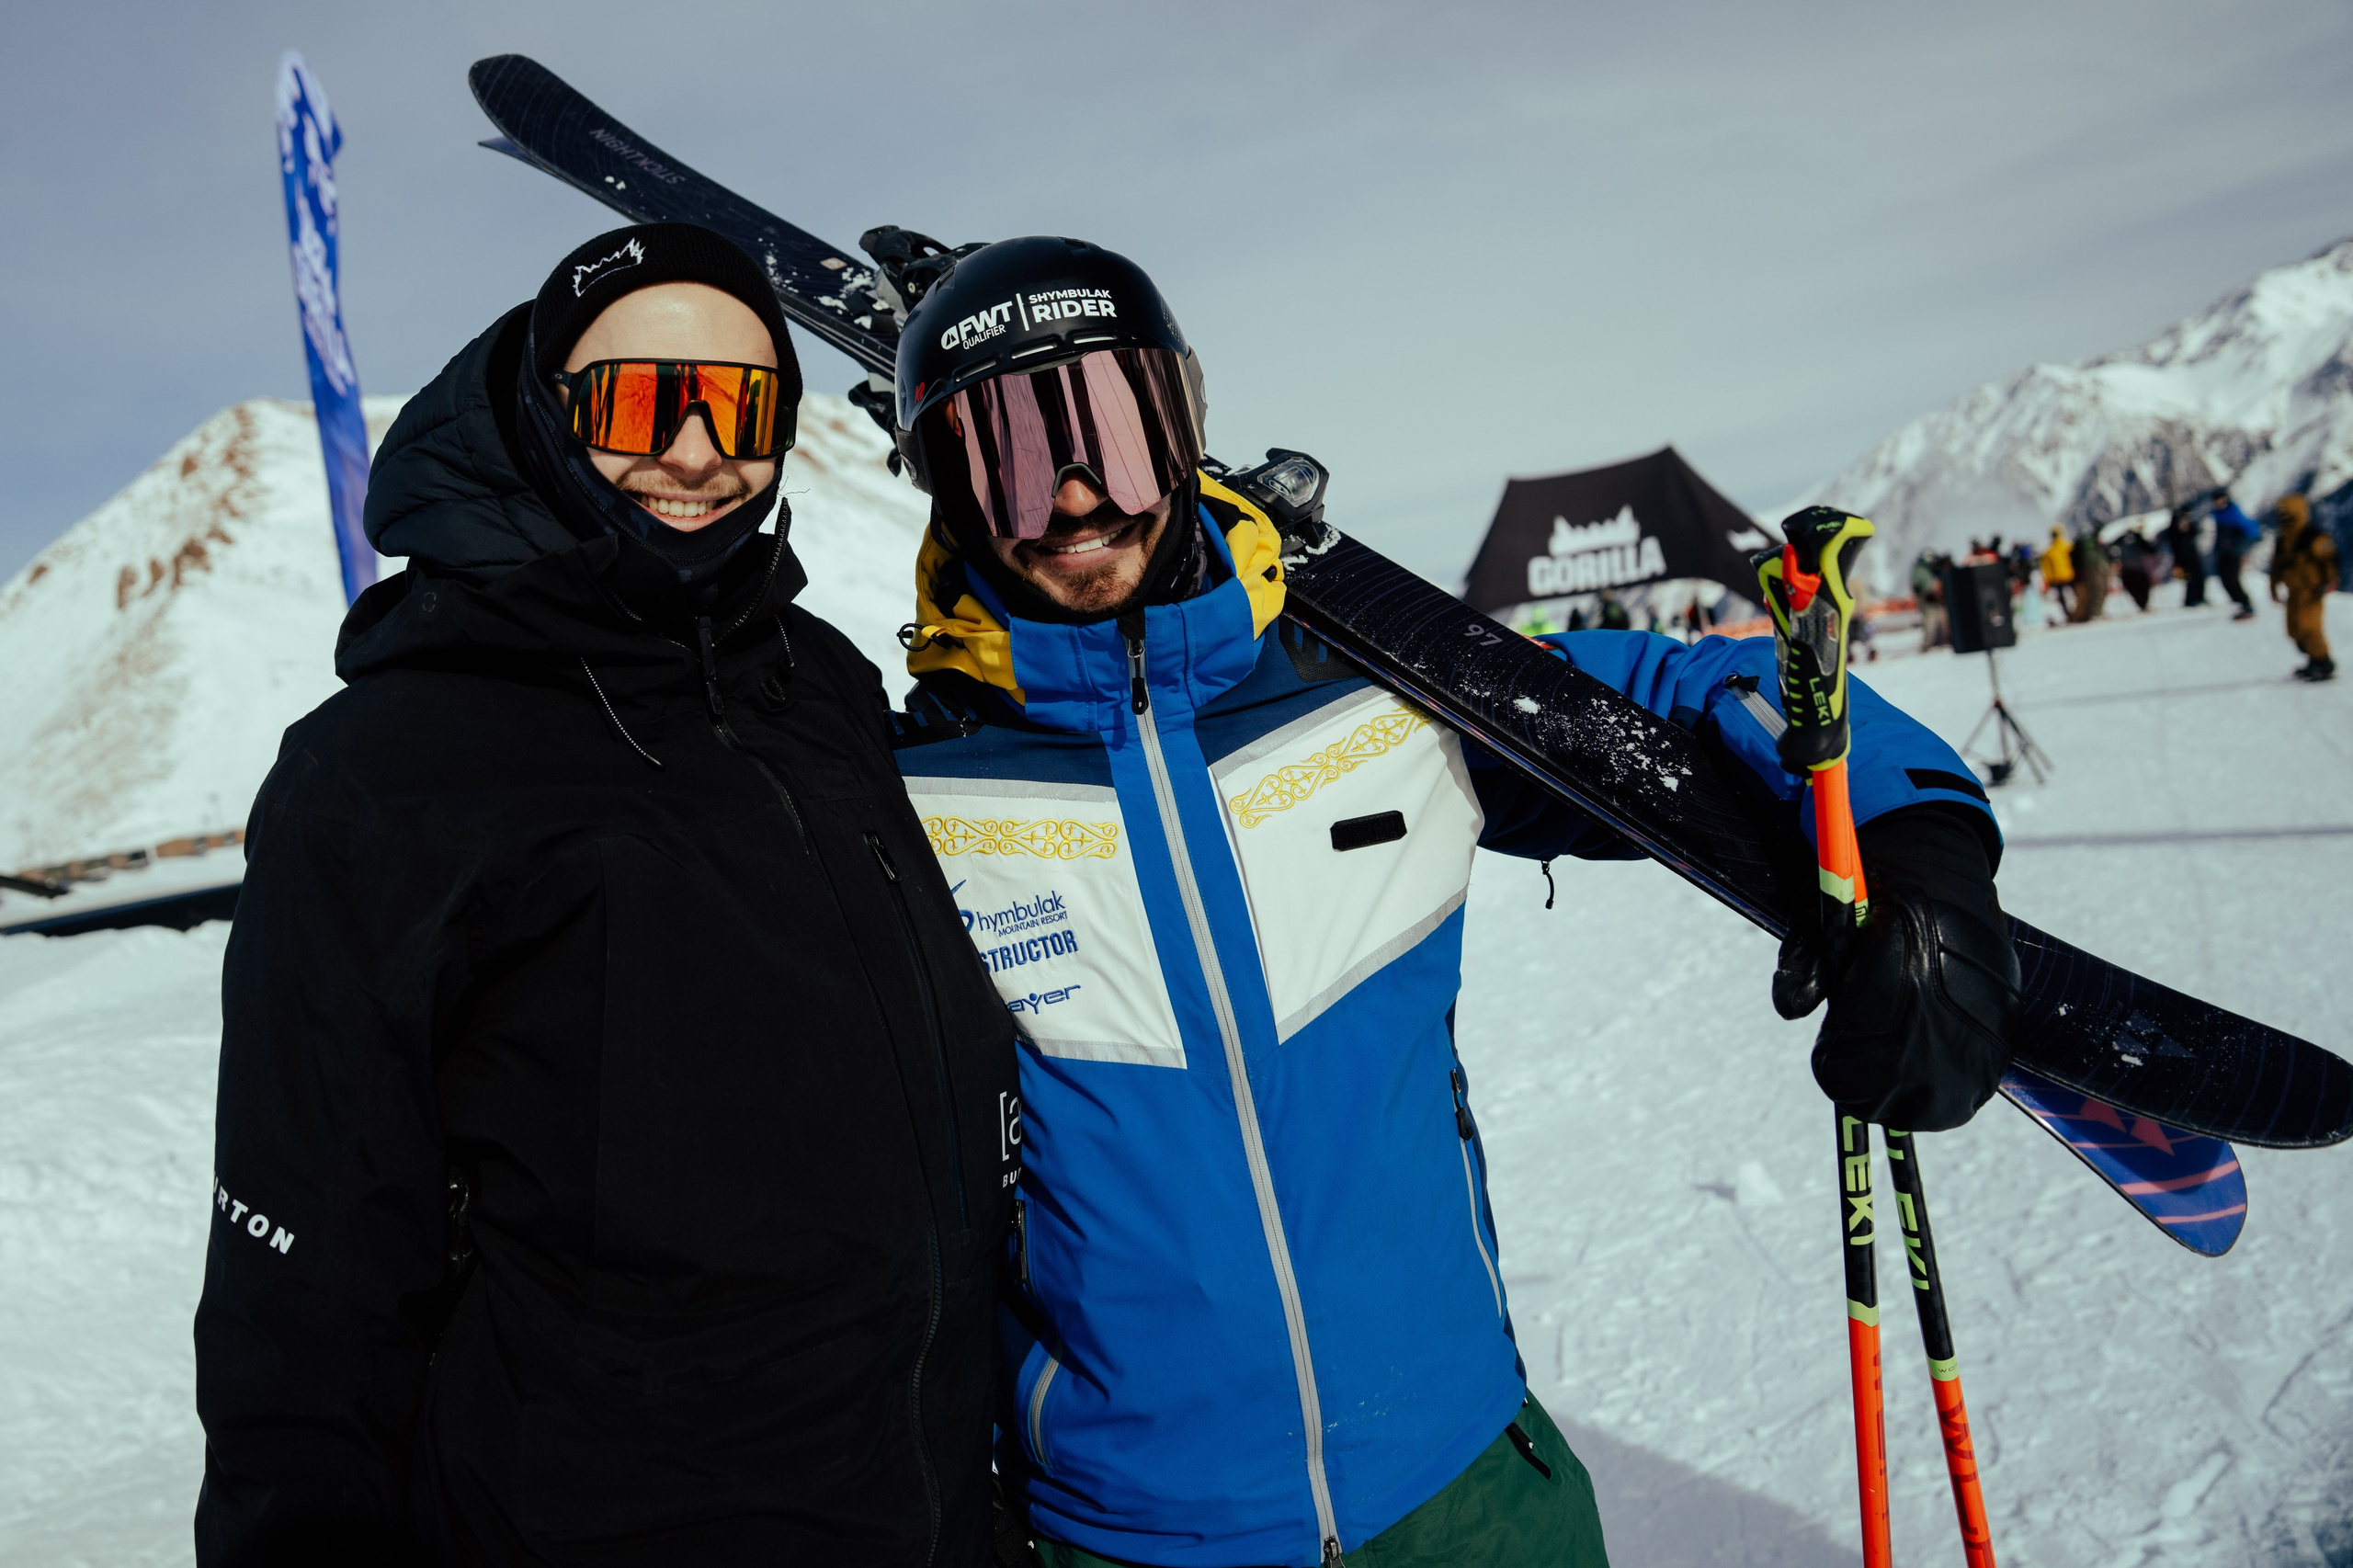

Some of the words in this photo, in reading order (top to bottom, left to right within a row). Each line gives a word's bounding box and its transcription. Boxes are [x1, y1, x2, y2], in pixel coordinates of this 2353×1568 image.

[1029, 289, 1112, 305] SHYMBULAK
[1031, 299, 1118, 324] RIDER
[958, 301, 1013, 342] FWT
[962, 324, 1006, 350] QUALIFIER
[1528, 536, 1667, 597] GORILLA
[1464, 624, 1503, 646] 97
[1809, 676, 1832, 726] LEKI
[998, 919, 1040, 937] MOUNTAIN
[1040, 910, 1068, 926] RESORT
[1006, 984, 1082, 1015] ayer
[213, 1176, 295, 1256] RTON
